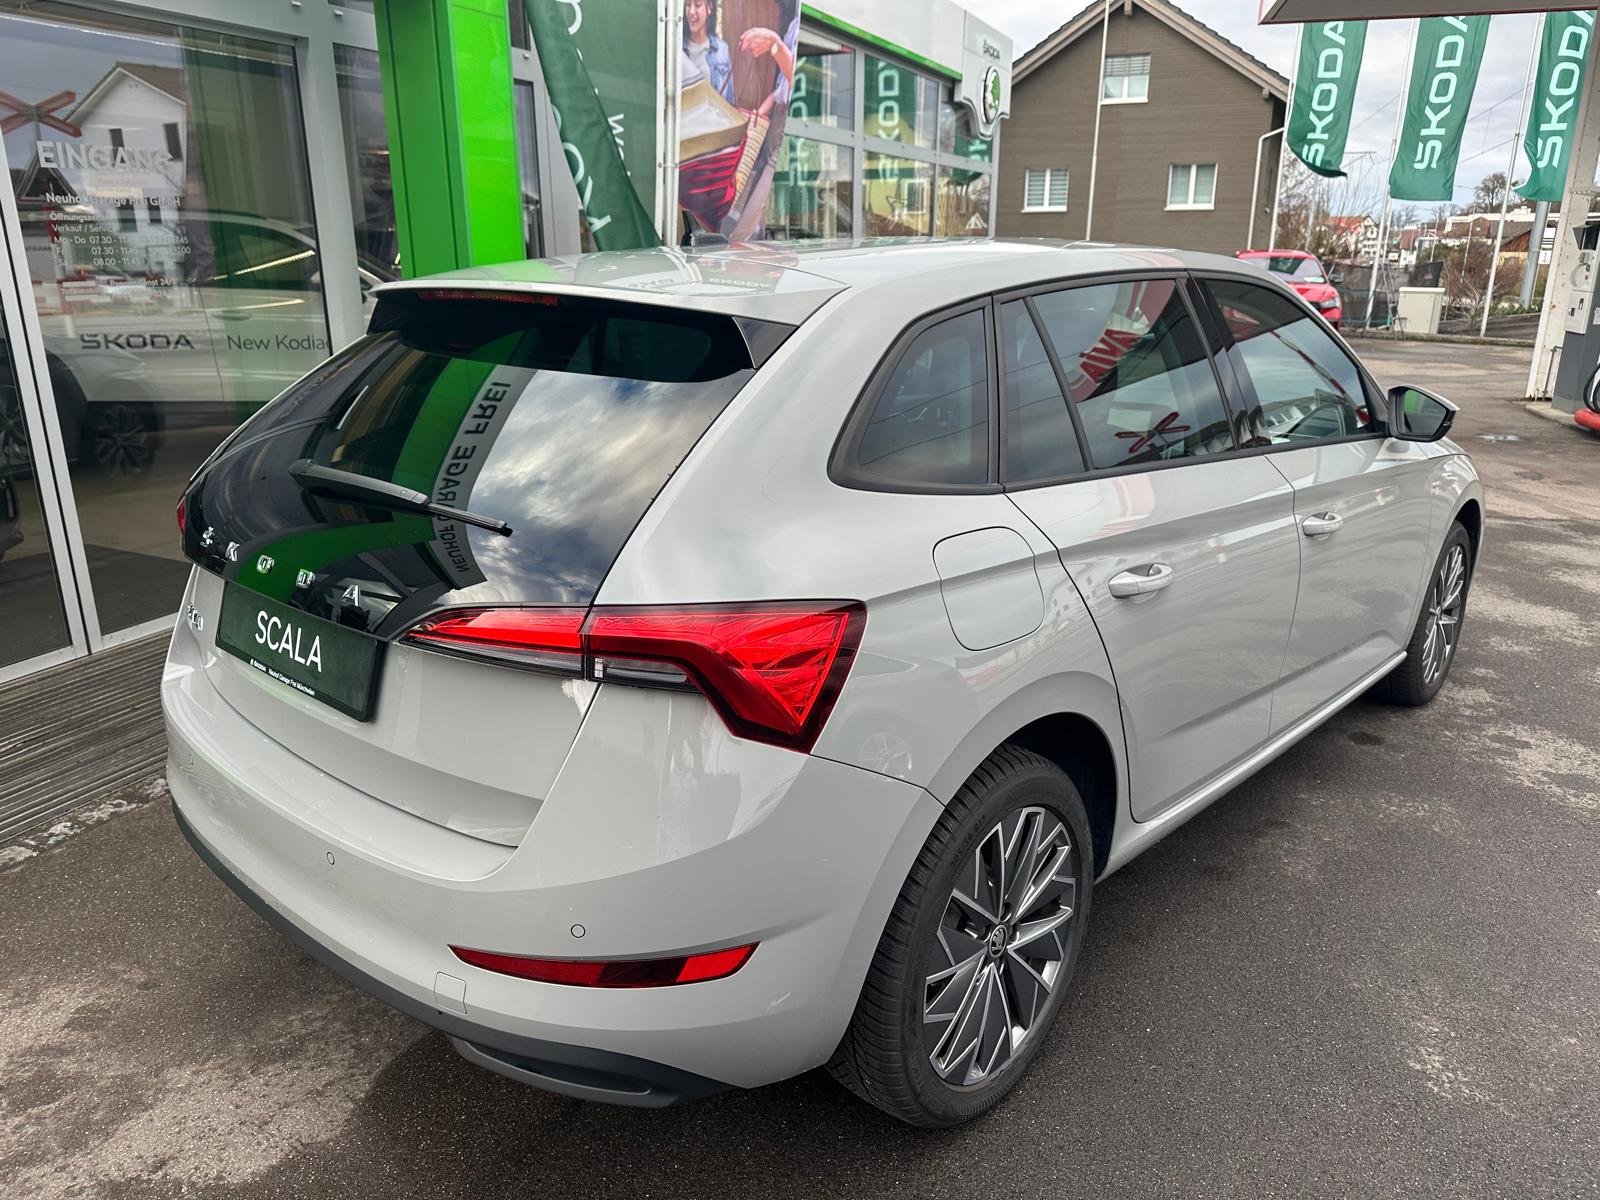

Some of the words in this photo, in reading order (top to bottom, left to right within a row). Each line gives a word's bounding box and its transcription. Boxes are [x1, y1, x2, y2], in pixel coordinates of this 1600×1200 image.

[46, 192, 86, 204] Neuho
[227, 335, 271, 351] New
[254, 610, 322, 673] SCALA
